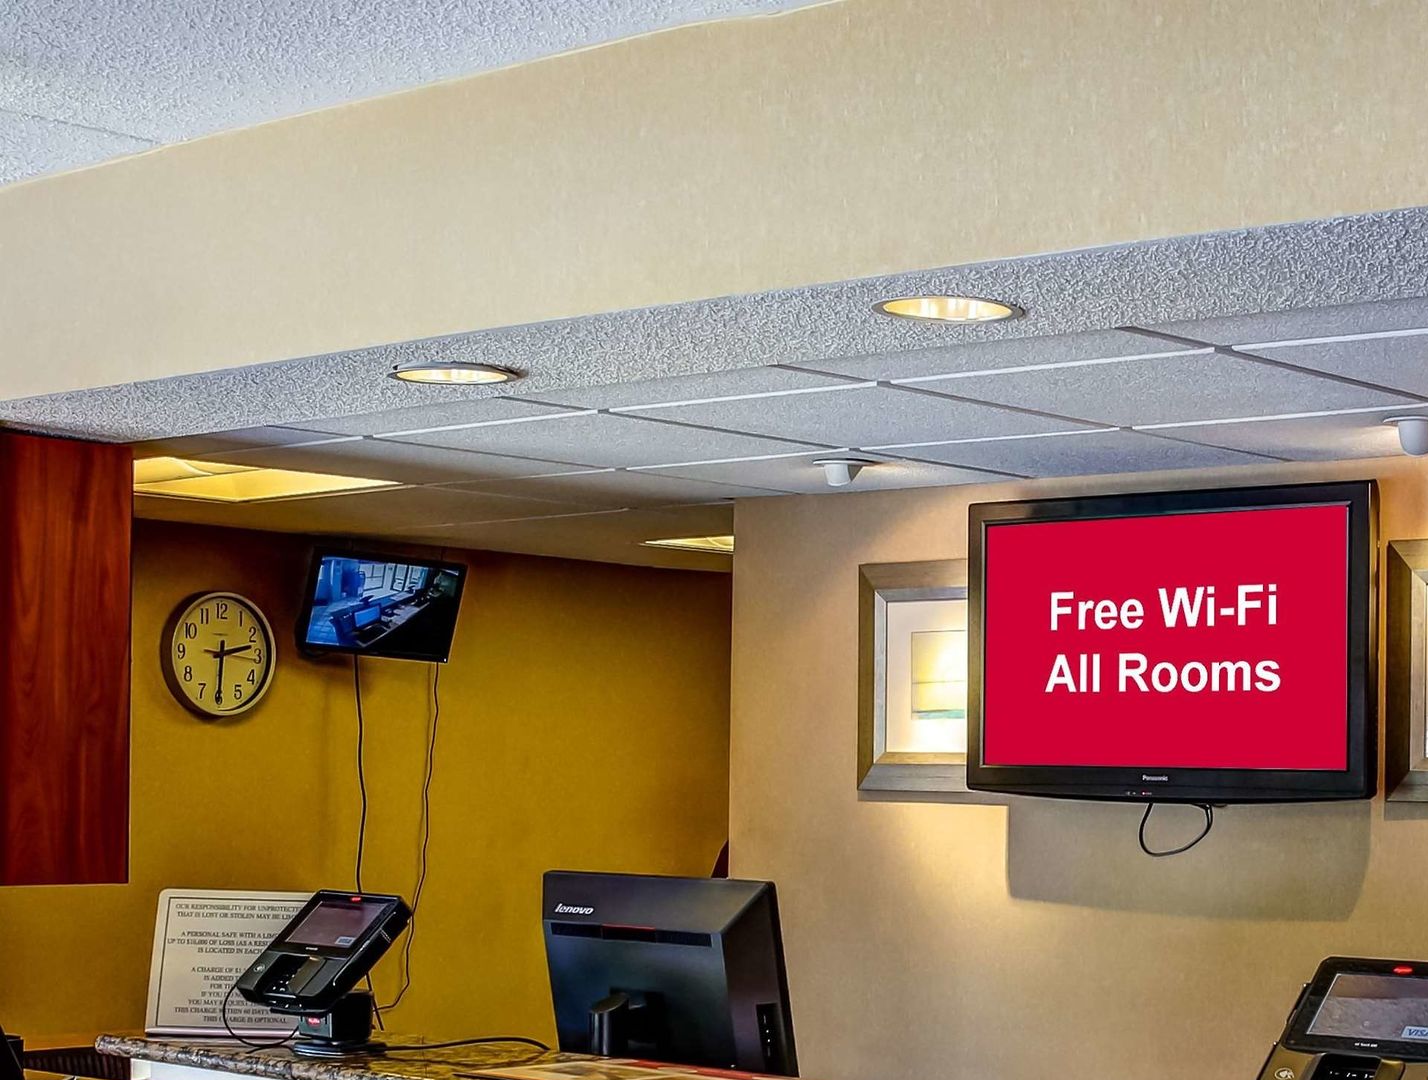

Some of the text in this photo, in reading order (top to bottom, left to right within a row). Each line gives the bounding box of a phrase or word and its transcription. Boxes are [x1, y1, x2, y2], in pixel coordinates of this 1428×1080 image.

[216, 603, 228, 619] 12
[1050, 584, 1277, 631] Free Wi-Fi
[200, 608, 209, 624] 11
[239, 610, 243, 627] 1
[185, 623, 197, 639] 10
[249, 626, 257, 643] 2
[177, 643, 186, 659] 9
[253, 648, 262, 664] 3
[184, 666, 192, 682] 8
[247, 669, 256, 685] 4
[1045, 653, 1281, 692] All Rooms
[198, 683, 206, 699] 7
[234, 685, 242, 700] 5
[554, 903, 594, 915] lenovo
